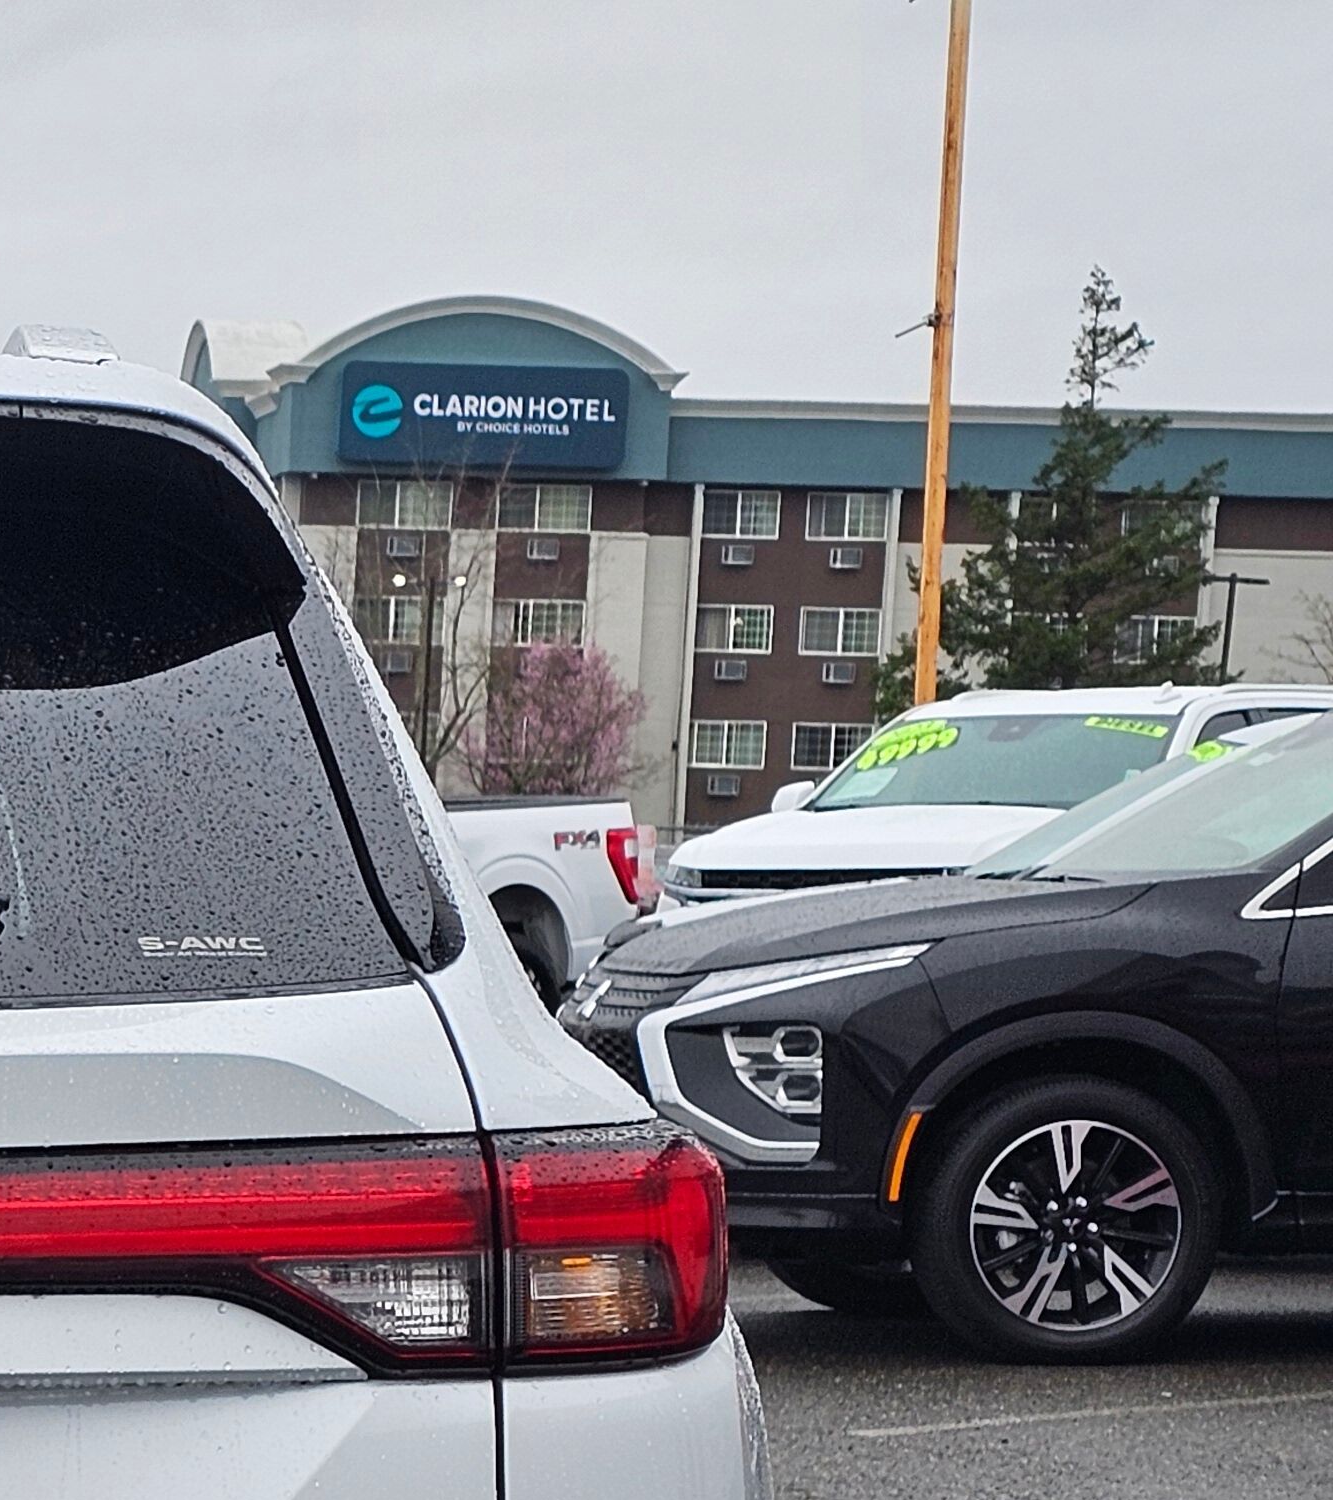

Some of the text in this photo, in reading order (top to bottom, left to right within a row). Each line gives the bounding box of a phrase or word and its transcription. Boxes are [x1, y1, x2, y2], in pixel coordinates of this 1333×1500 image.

[413, 393, 616, 423] CLARION HOTEL
[457, 421, 570, 436] BY CHOICE HOTELS
[553, 830, 601, 851] FX4
[137, 936, 265, 950] S-AWC
